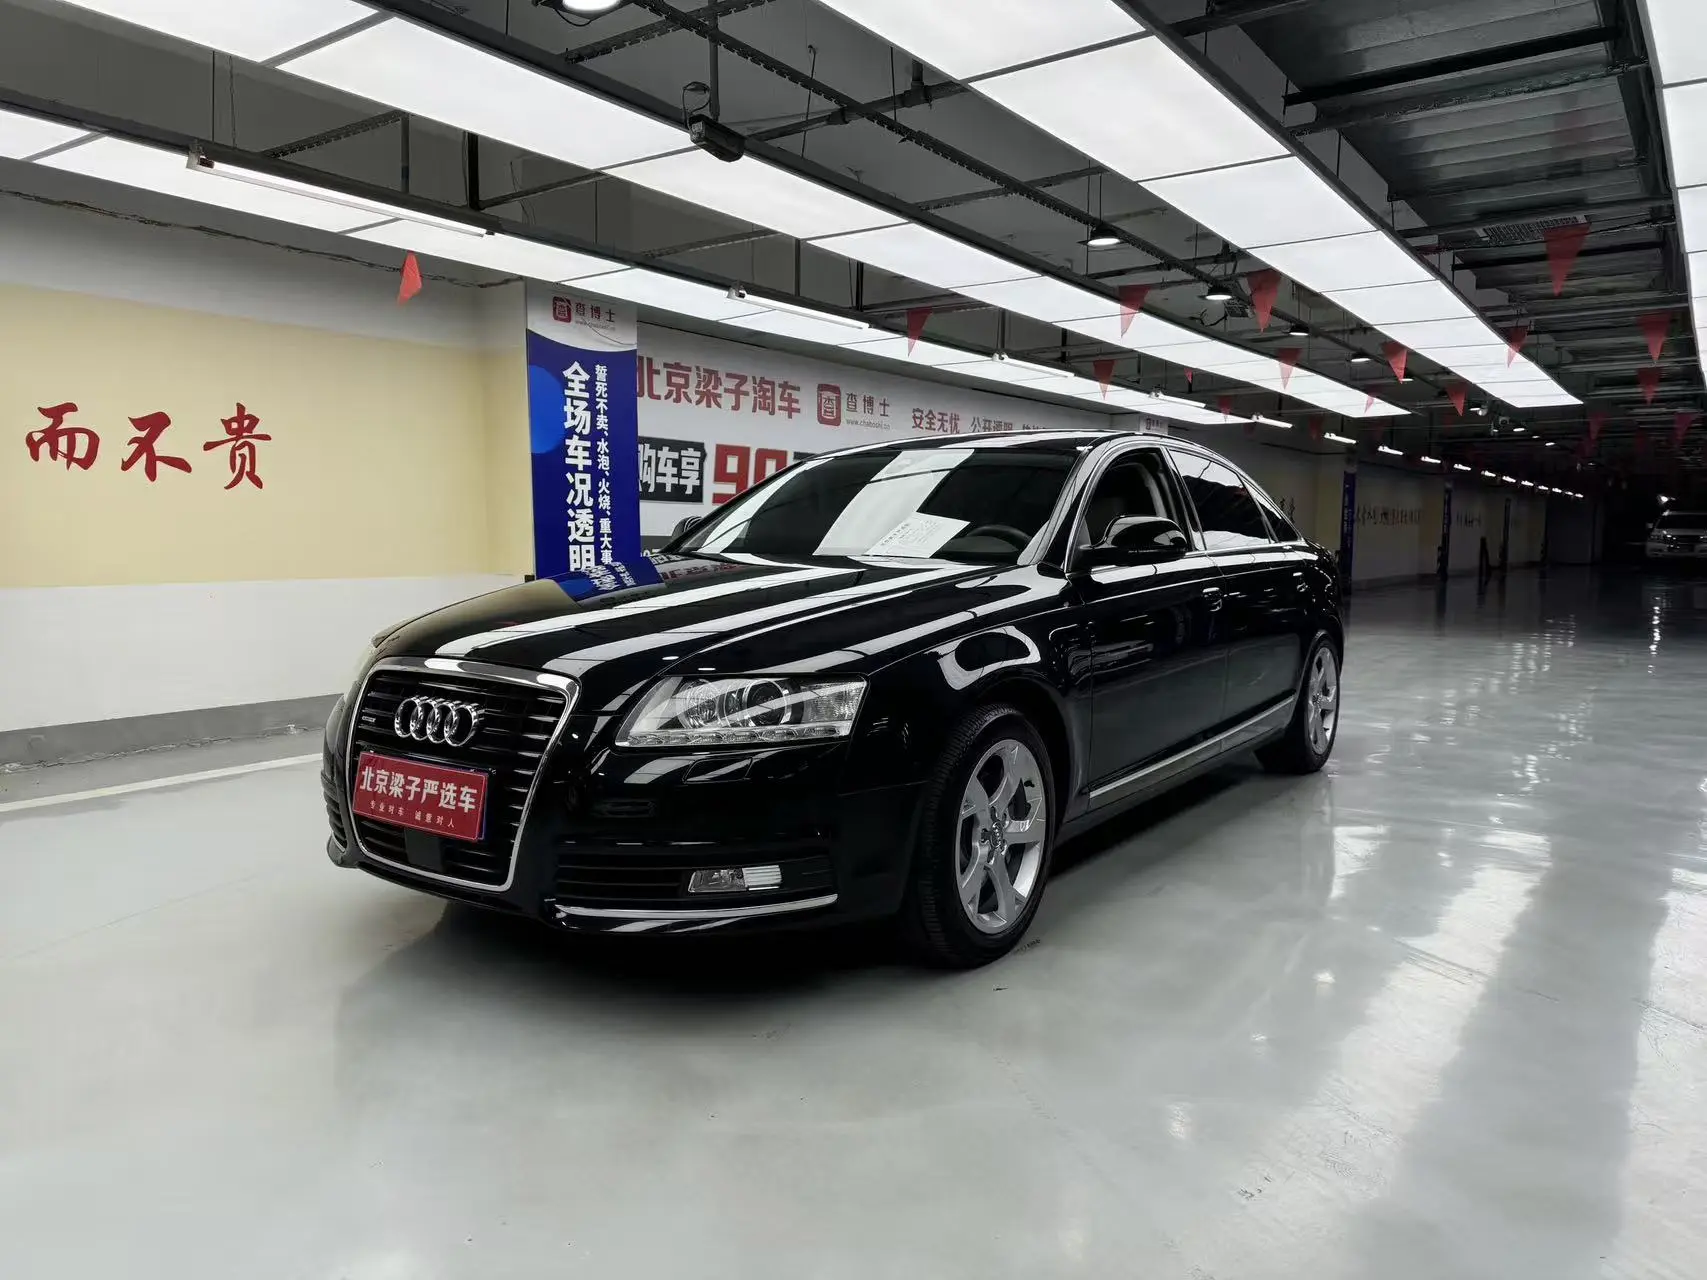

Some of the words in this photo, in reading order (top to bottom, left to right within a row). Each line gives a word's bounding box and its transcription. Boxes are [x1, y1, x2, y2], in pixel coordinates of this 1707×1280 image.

[575, 302, 616, 323] 查博士
[637, 355, 801, 419] 北京梁子淘车
[845, 392, 891, 418] 查博士
[911, 407, 961, 434] 安全无忧
[25, 402, 272, 490] 而不贵
[562, 361, 597, 572] 全场车况透明
[638, 443, 702, 496] 购车享
[359, 766, 478, 813] 北京梁子严选车
